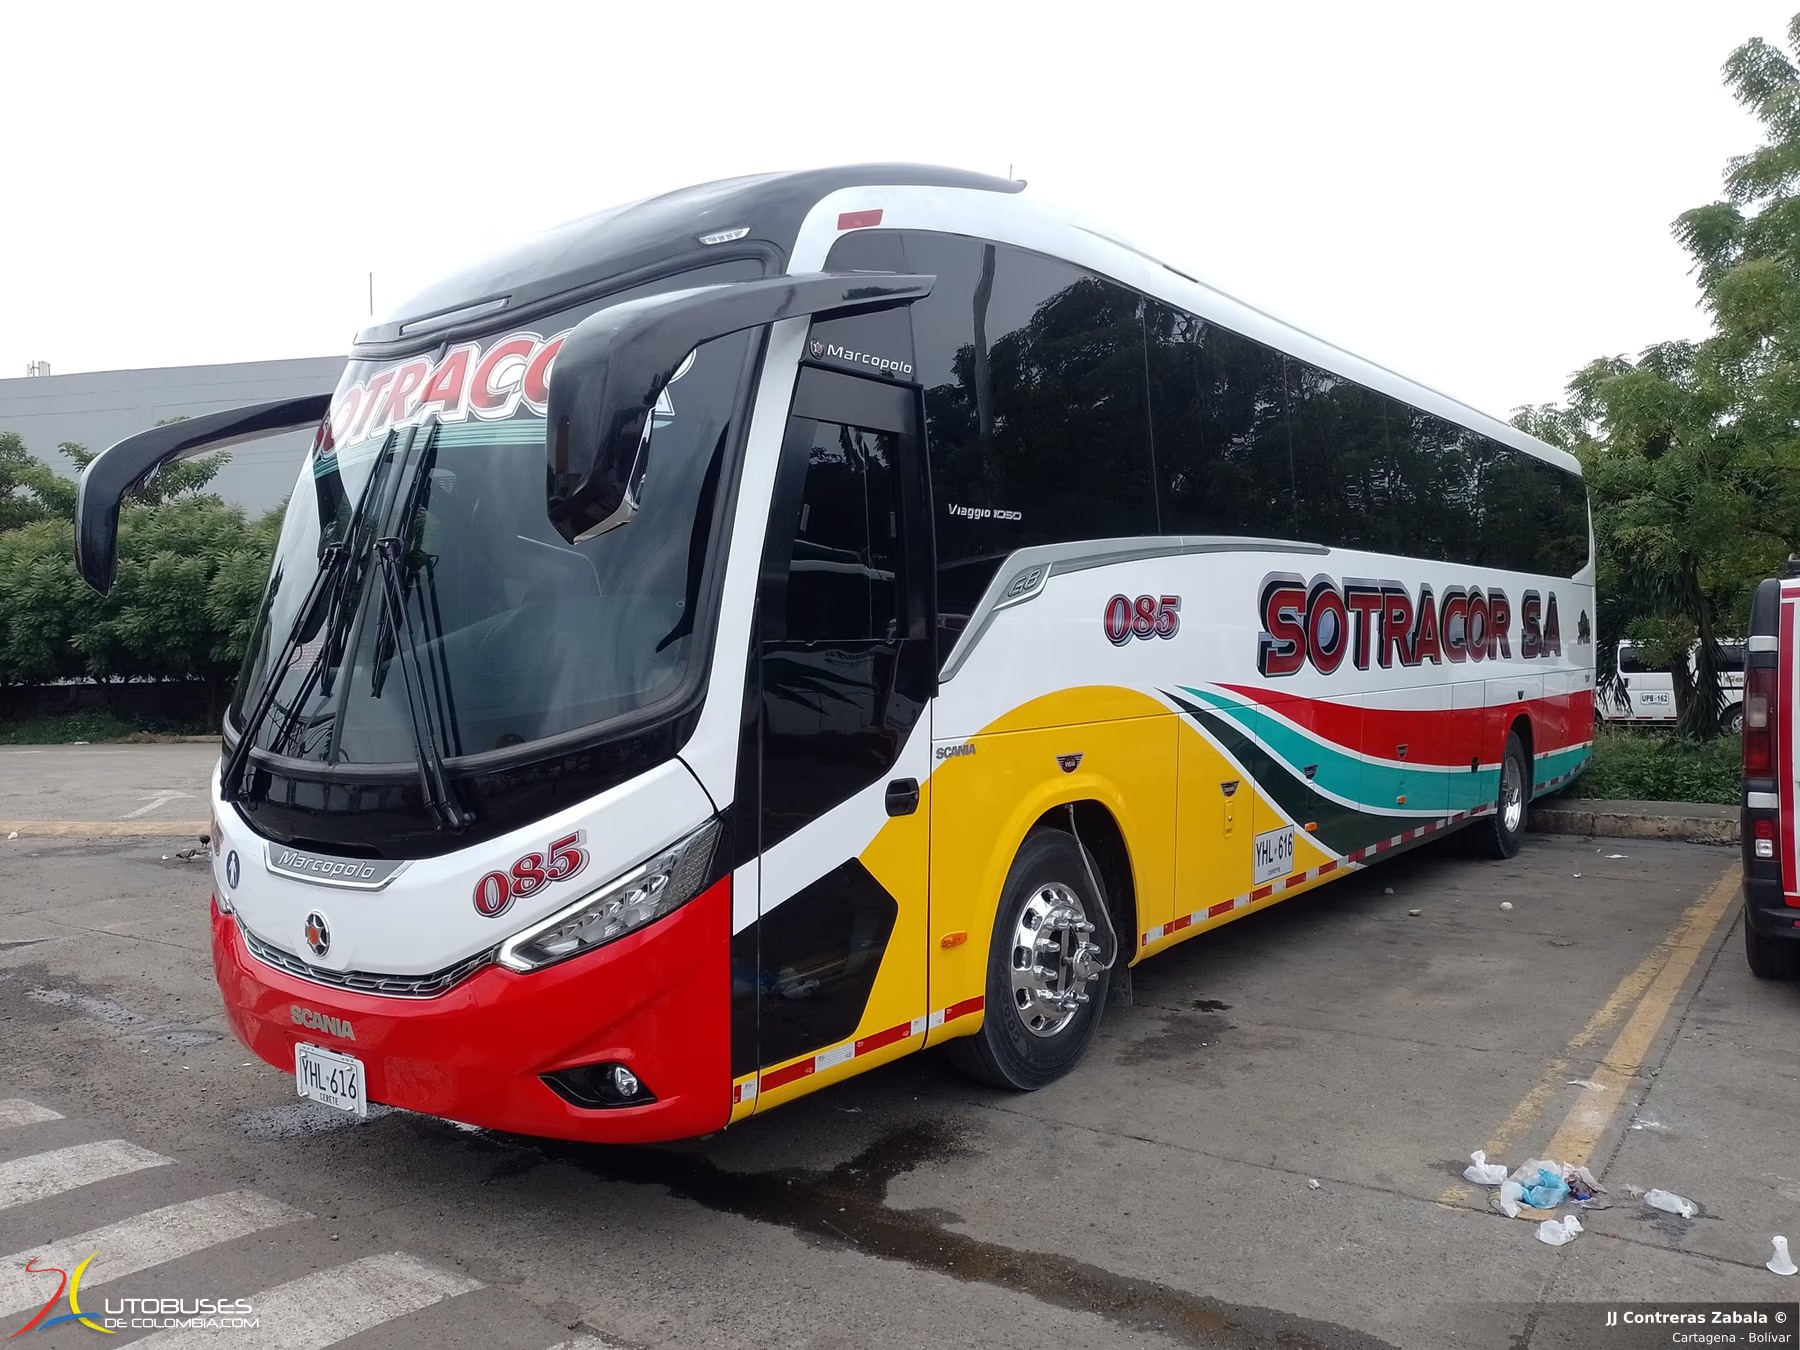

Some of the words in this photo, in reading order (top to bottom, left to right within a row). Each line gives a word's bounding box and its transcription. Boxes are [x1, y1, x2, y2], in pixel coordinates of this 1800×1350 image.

[827, 344, 913, 374] Marcopolo
[948, 503, 991, 520] Viaggio
[993, 508, 1022, 521] 1050
[1104, 593, 1181, 647] 085
[1257, 571, 1512, 678] SOTRACOR
[936, 744, 976, 759] SCANIA
[278, 849, 376, 881] Marcopolo
[473, 829, 591, 918] 085
[290, 1005, 356, 1041] SCANIA
[320, 1092, 339, 1106] CERETE
